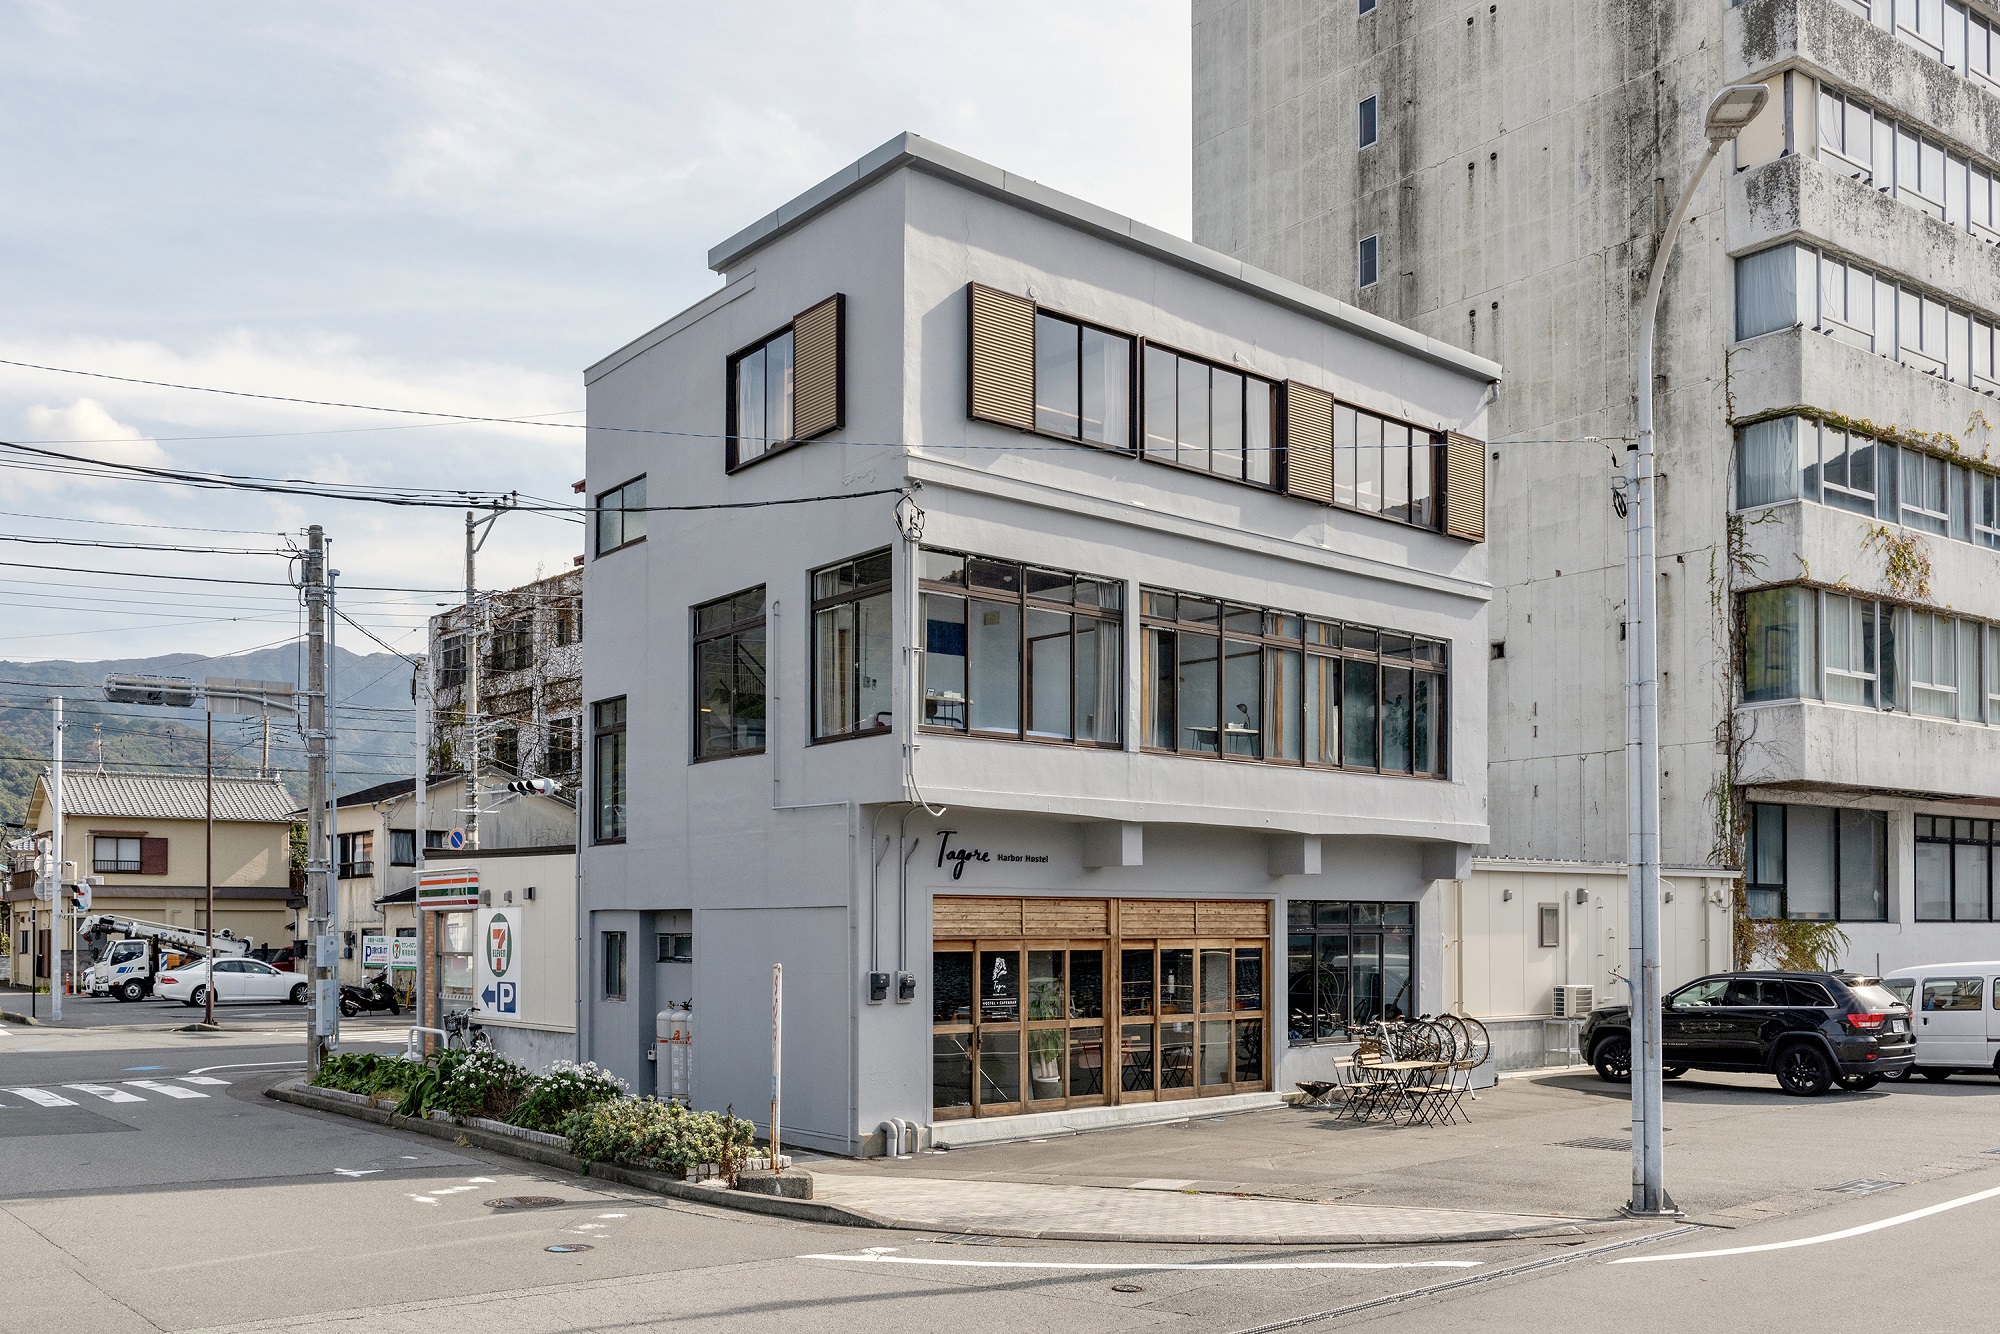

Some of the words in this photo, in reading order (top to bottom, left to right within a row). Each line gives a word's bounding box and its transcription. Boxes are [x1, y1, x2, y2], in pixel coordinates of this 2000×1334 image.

[937, 830, 991, 880] Tagore
[997, 853, 1024, 863] Harbor
[1025, 854, 1049, 863] Hostel
[366, 946, 372, 961] P
[499, 983, 514, 1011] P
